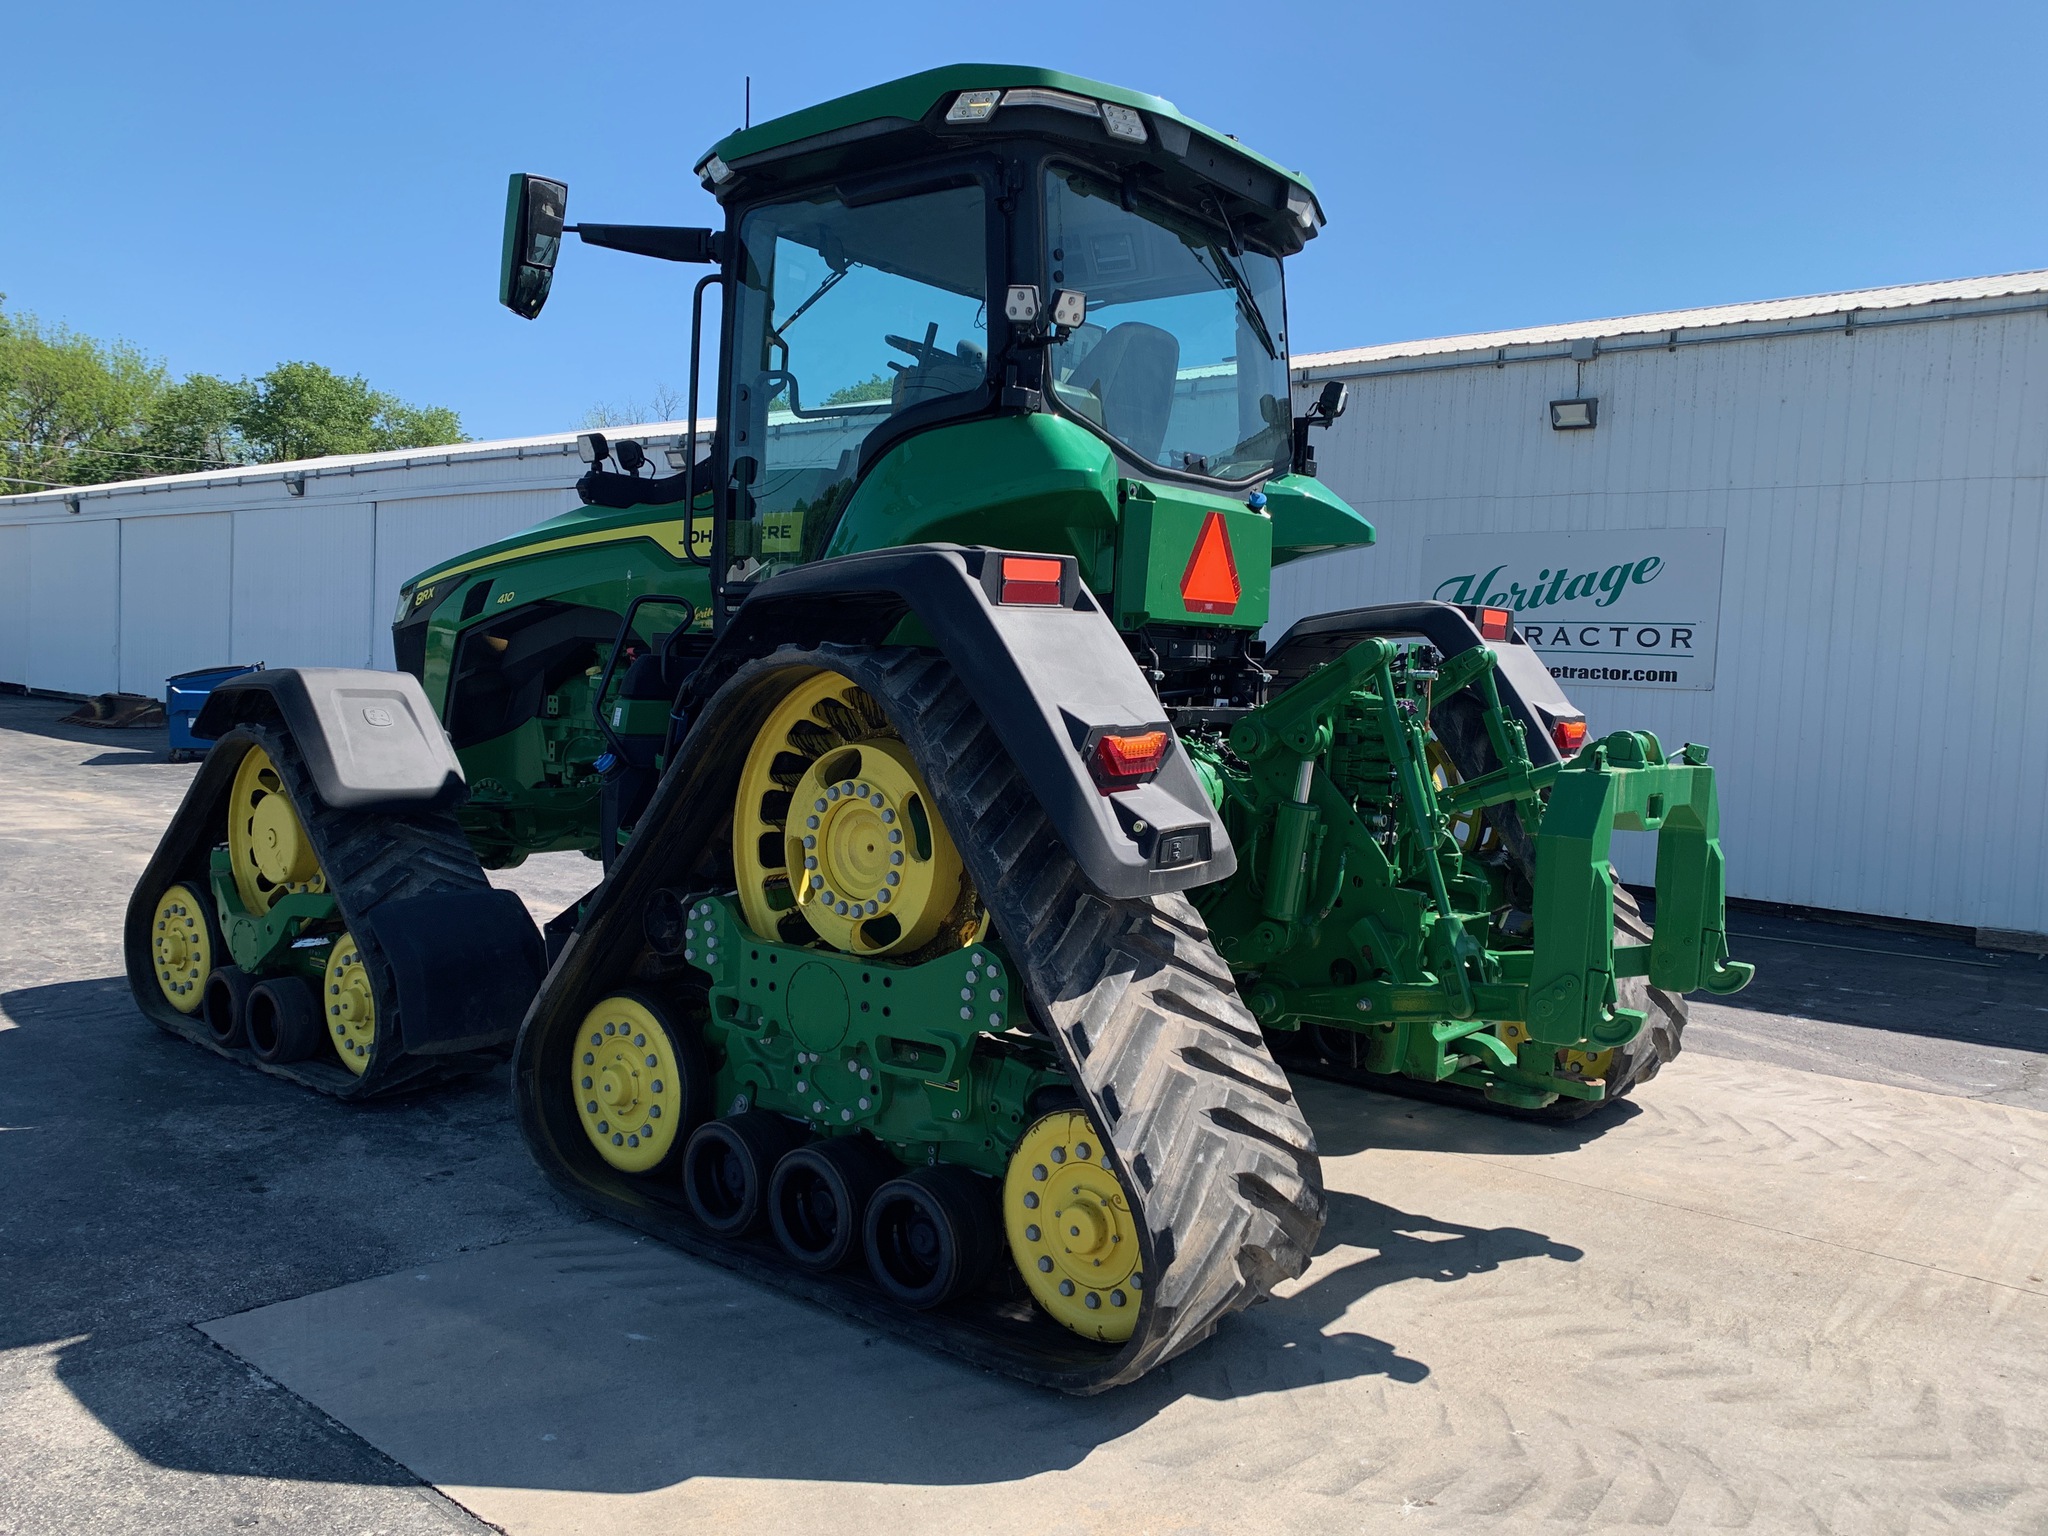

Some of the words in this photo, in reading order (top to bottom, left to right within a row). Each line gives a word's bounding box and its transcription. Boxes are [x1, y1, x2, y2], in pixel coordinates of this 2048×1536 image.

[1433, 556, 1666, 612] Heritage
[415, 586, 435, 606] 8RX
[497, 591, 515, 604] 410
[1514, 626, 1693, 650] RACTOR
[1546, 666, 1678, 683] etractor.com
